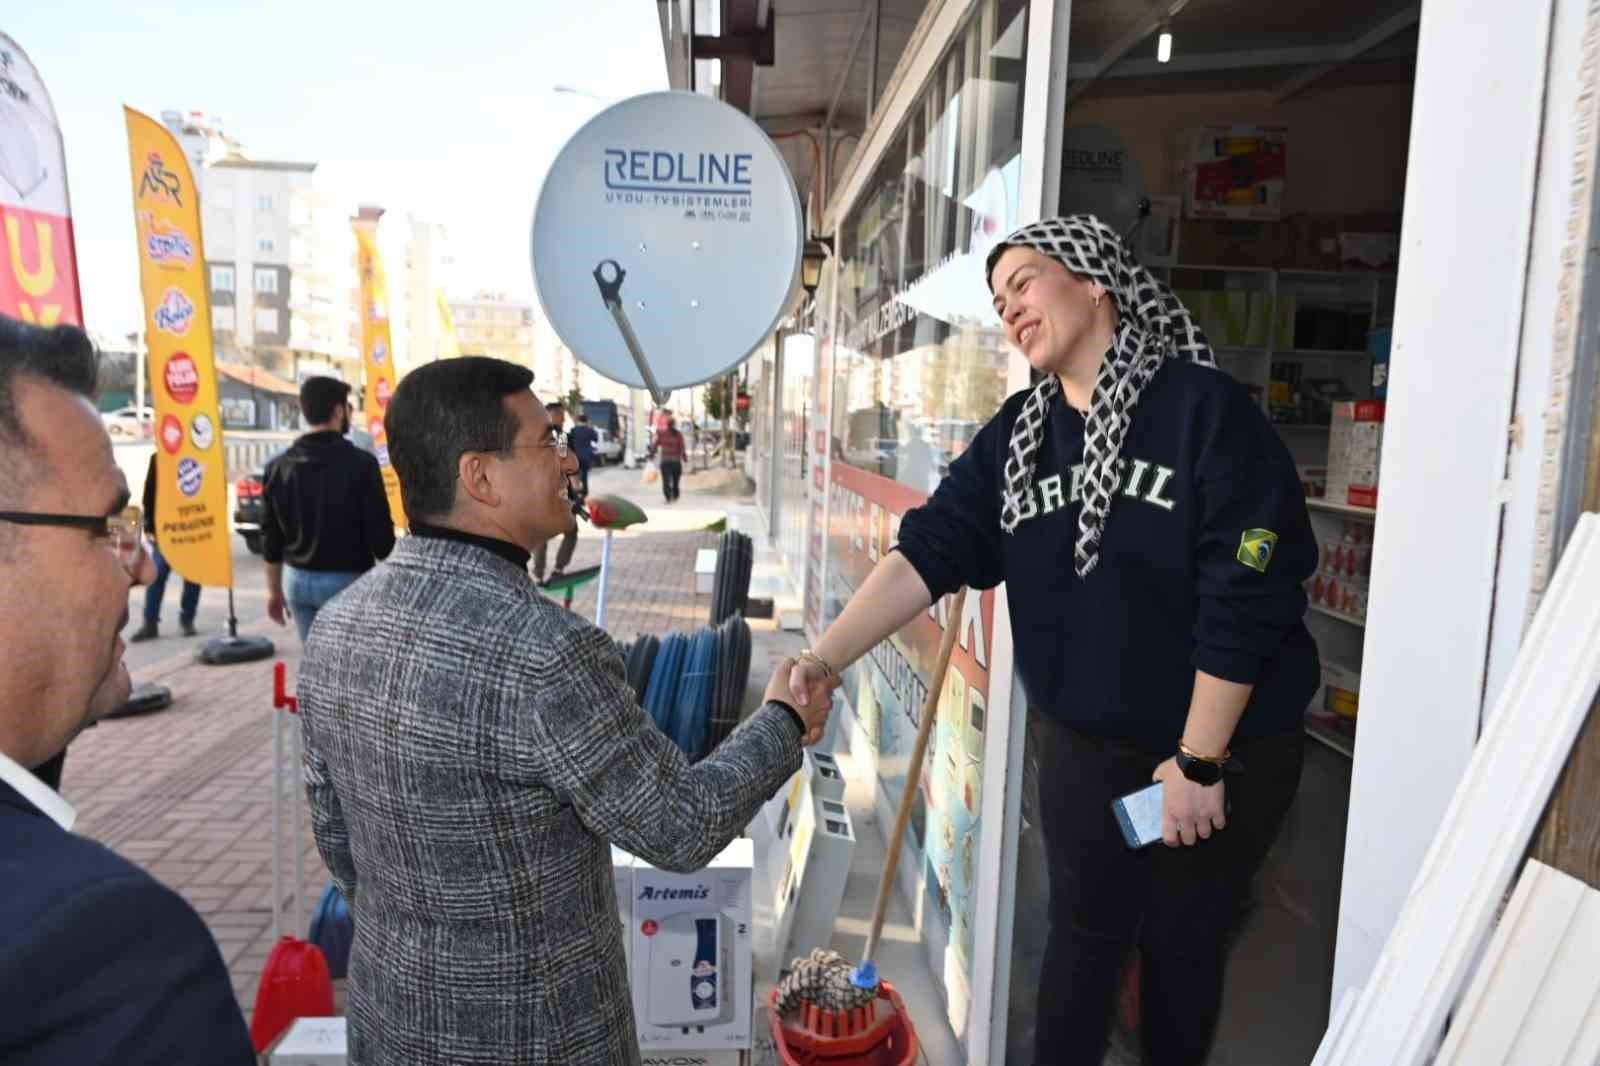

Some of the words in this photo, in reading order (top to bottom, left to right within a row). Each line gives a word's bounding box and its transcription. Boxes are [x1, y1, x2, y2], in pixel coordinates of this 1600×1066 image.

[604, 149, 752, 186] REDLINE
[639, 884, 710, 900] Artemis
[643, 1056, 705, 1066] AWOX
